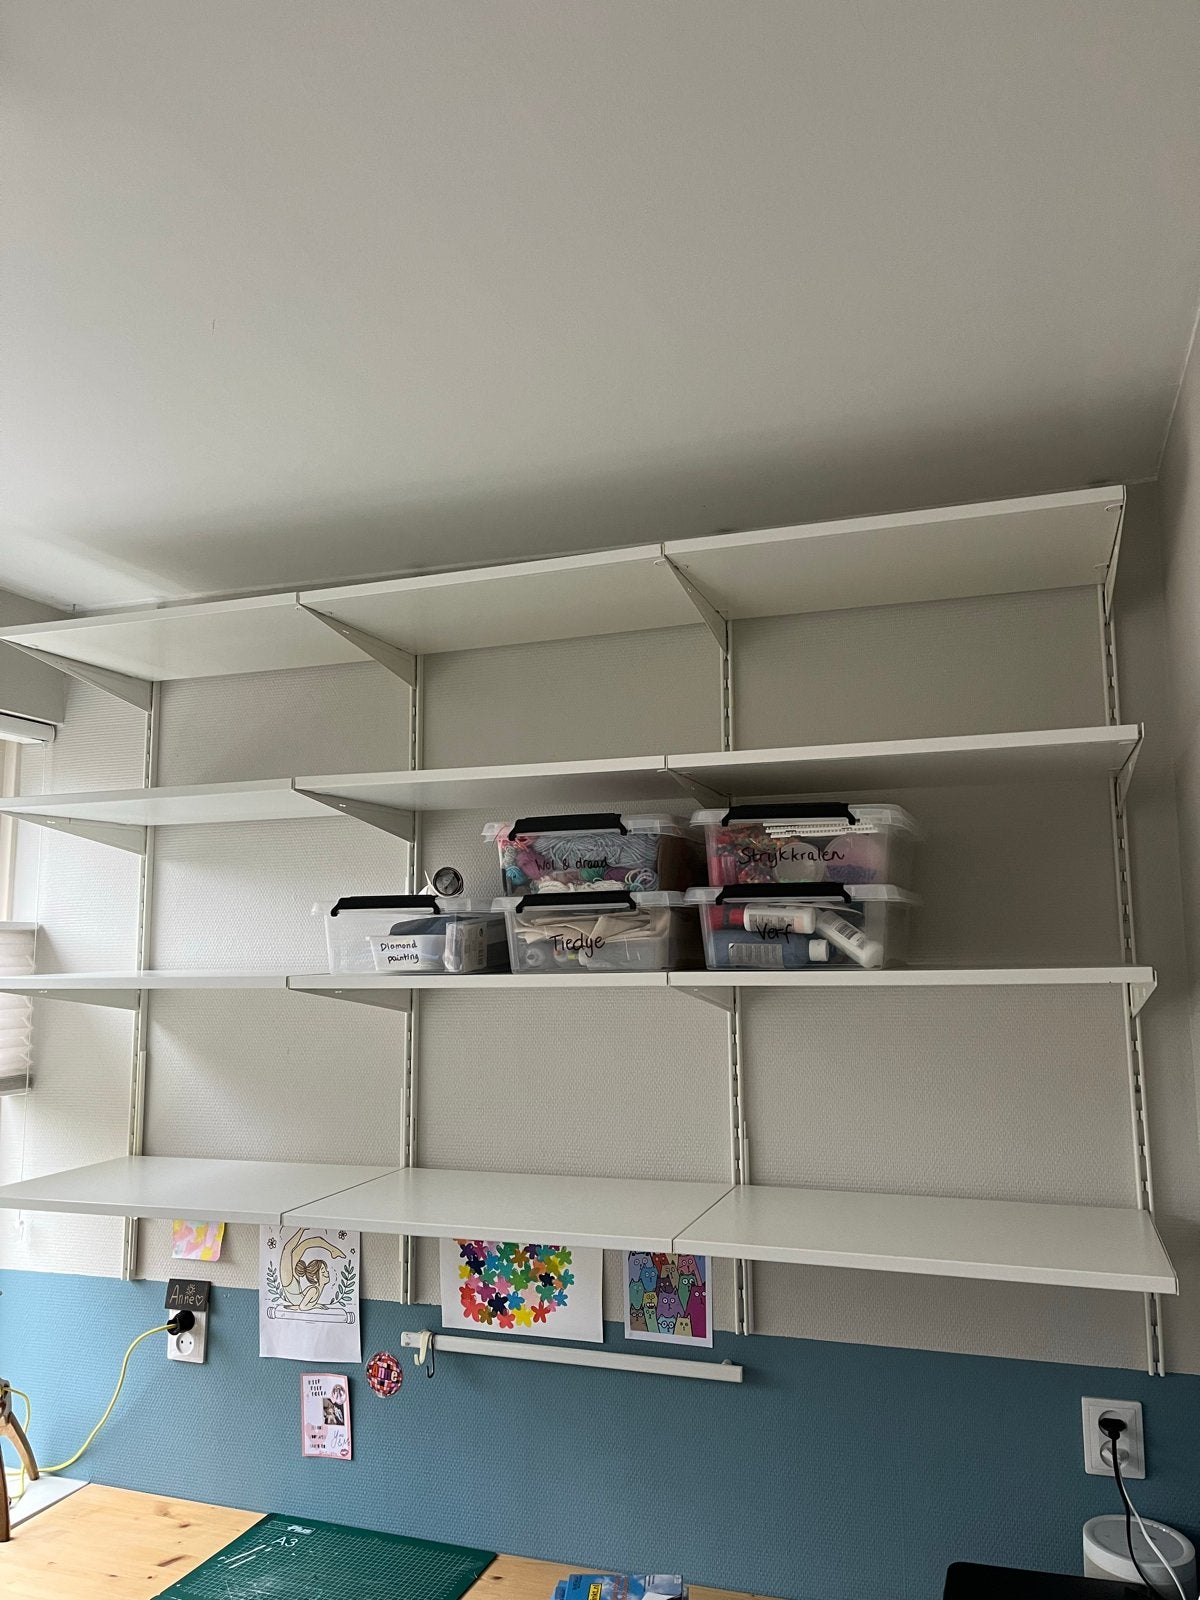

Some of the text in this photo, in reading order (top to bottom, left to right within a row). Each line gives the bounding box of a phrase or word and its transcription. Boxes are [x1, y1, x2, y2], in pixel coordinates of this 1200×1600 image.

[535, 856, 612, 872] Wol & draad
[738, 847, 845, 868] Strijkkralen
[756, 923, 792, 944] Verf
[380, 939, 418, 951] Diamond
[549, 934, 605, 962] Tiedye
[387, 952, 420, 964] painting
[169, 1284, 195, 1307] Anne
[371, 1362, 399, 1382] Anne
[271, 1536, 299, 1547] A3
